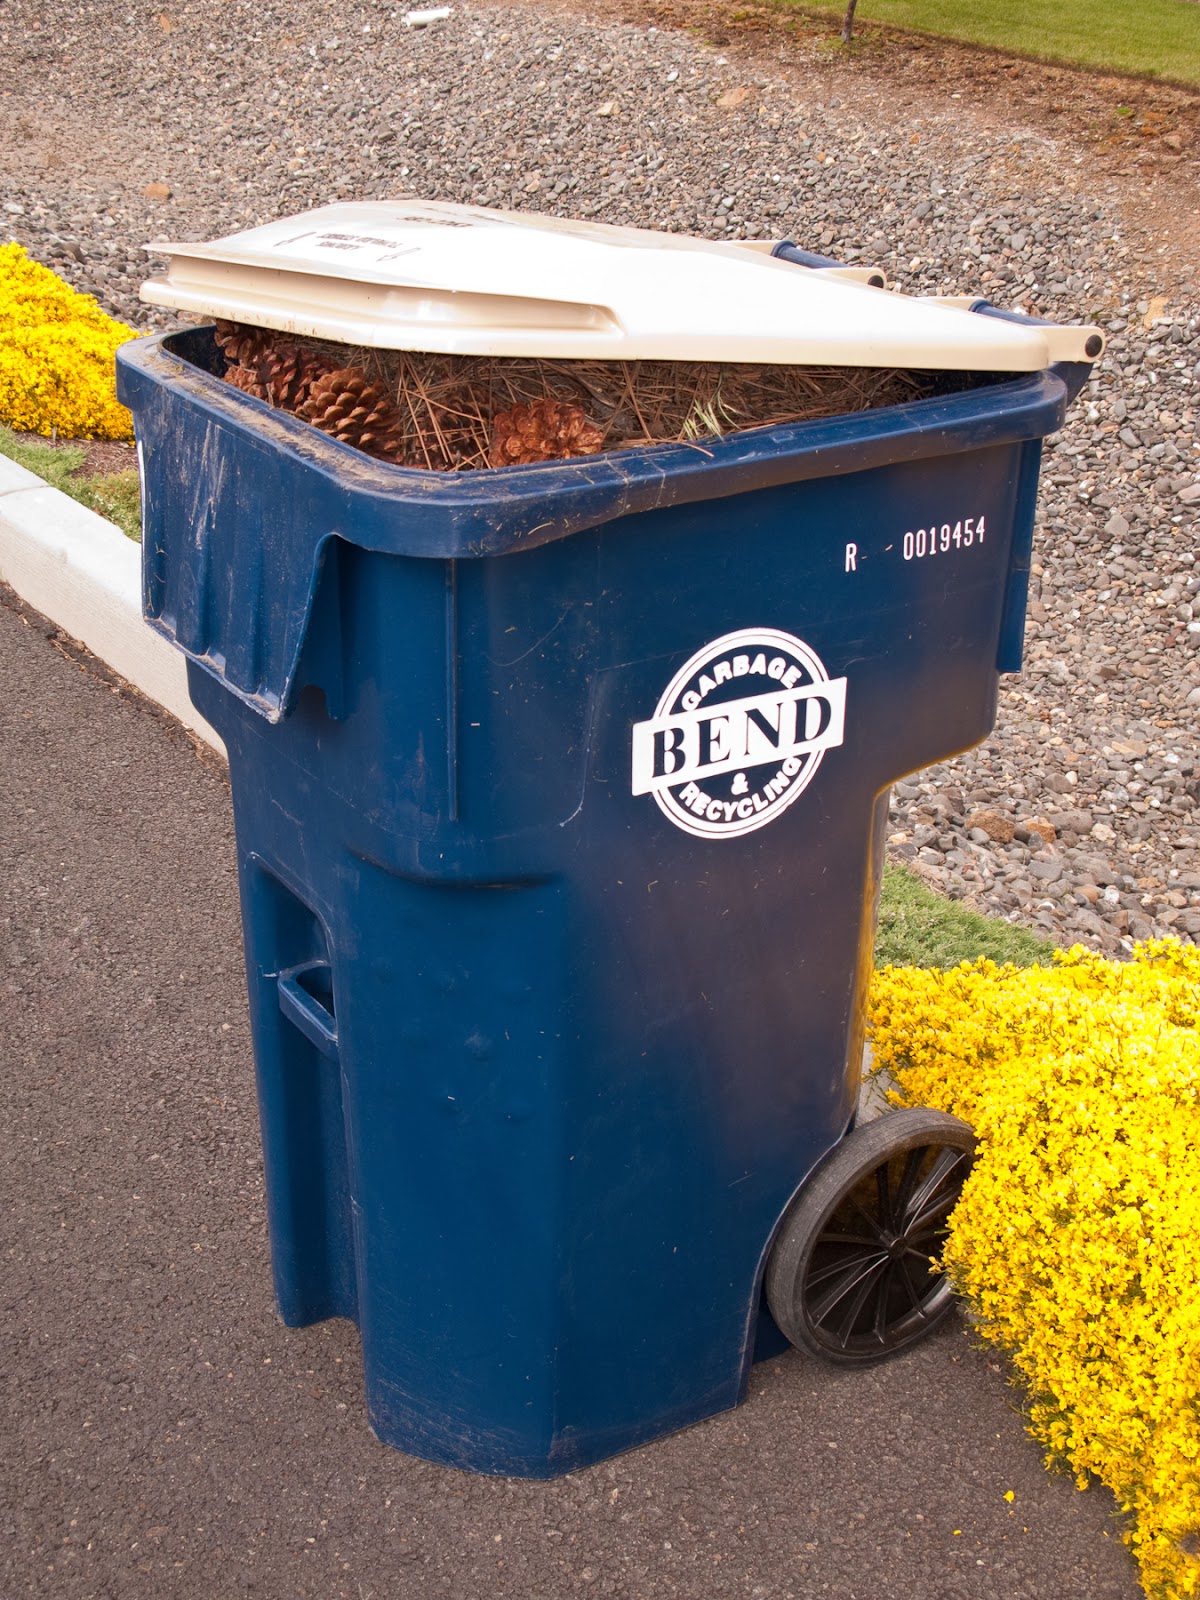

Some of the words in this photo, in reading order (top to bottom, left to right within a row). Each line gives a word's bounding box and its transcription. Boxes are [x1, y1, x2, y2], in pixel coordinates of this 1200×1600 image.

[844, 542, 857, 573] R
[903, 515, 985, 561] 0019454
[681, 653, 802, 711] GARBAGE
[651, 695, 832, 778] BEND
[679, 756, 802, 821] RECYCLING
[731, 772, 749, 795] &
